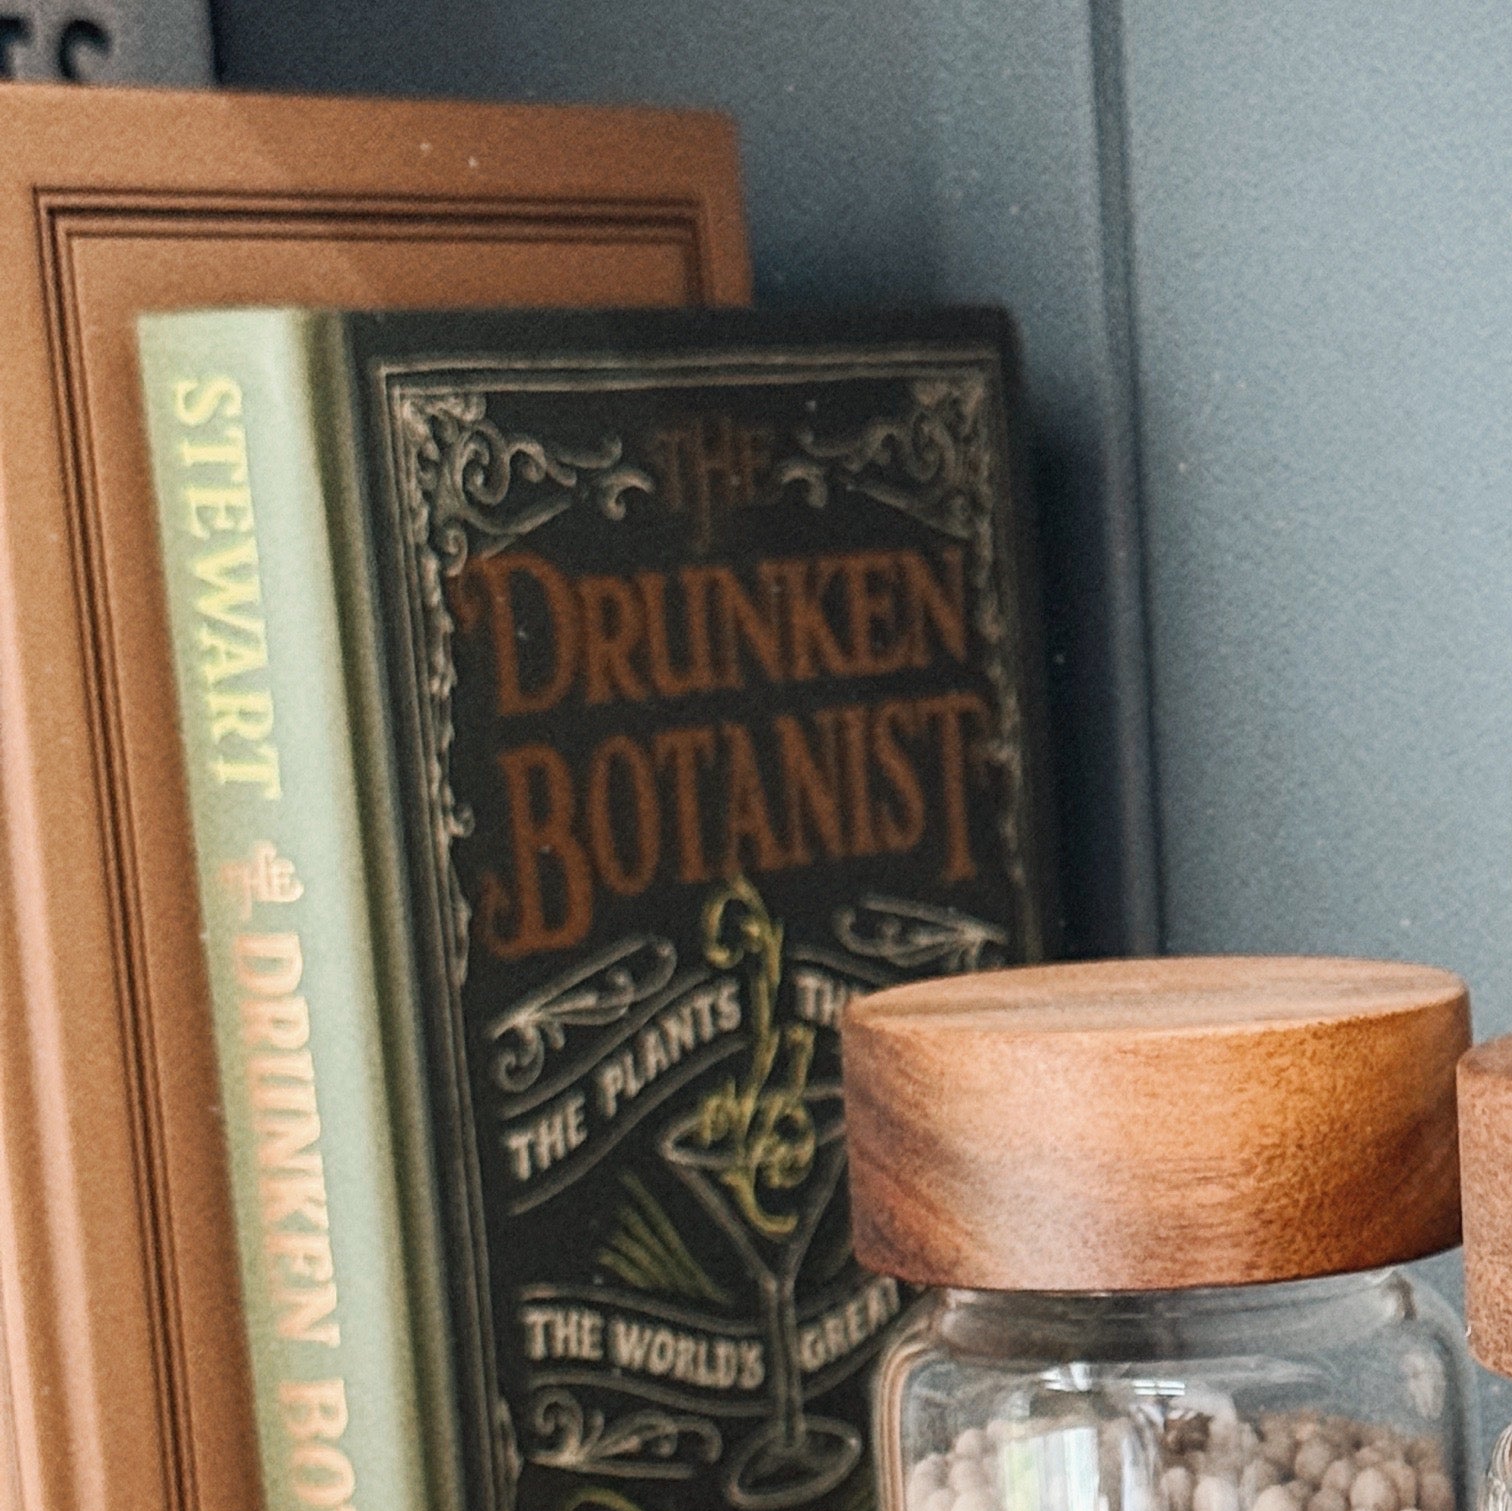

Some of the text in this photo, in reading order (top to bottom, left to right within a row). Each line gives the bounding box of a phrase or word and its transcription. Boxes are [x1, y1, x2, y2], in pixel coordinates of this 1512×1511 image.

[654, 415, 780, 535] THE
[173, 374, 282, 802] STEWART
[448, 546, 968, 717] DRUNKEN
[478, 690, 990, 960] BOTANIST
[232, 931, 342, 1349] DRUNKEN
[506, 968, 846, 1181] THE PLANTS TH
[523, 1309, 603, 1361] THE
